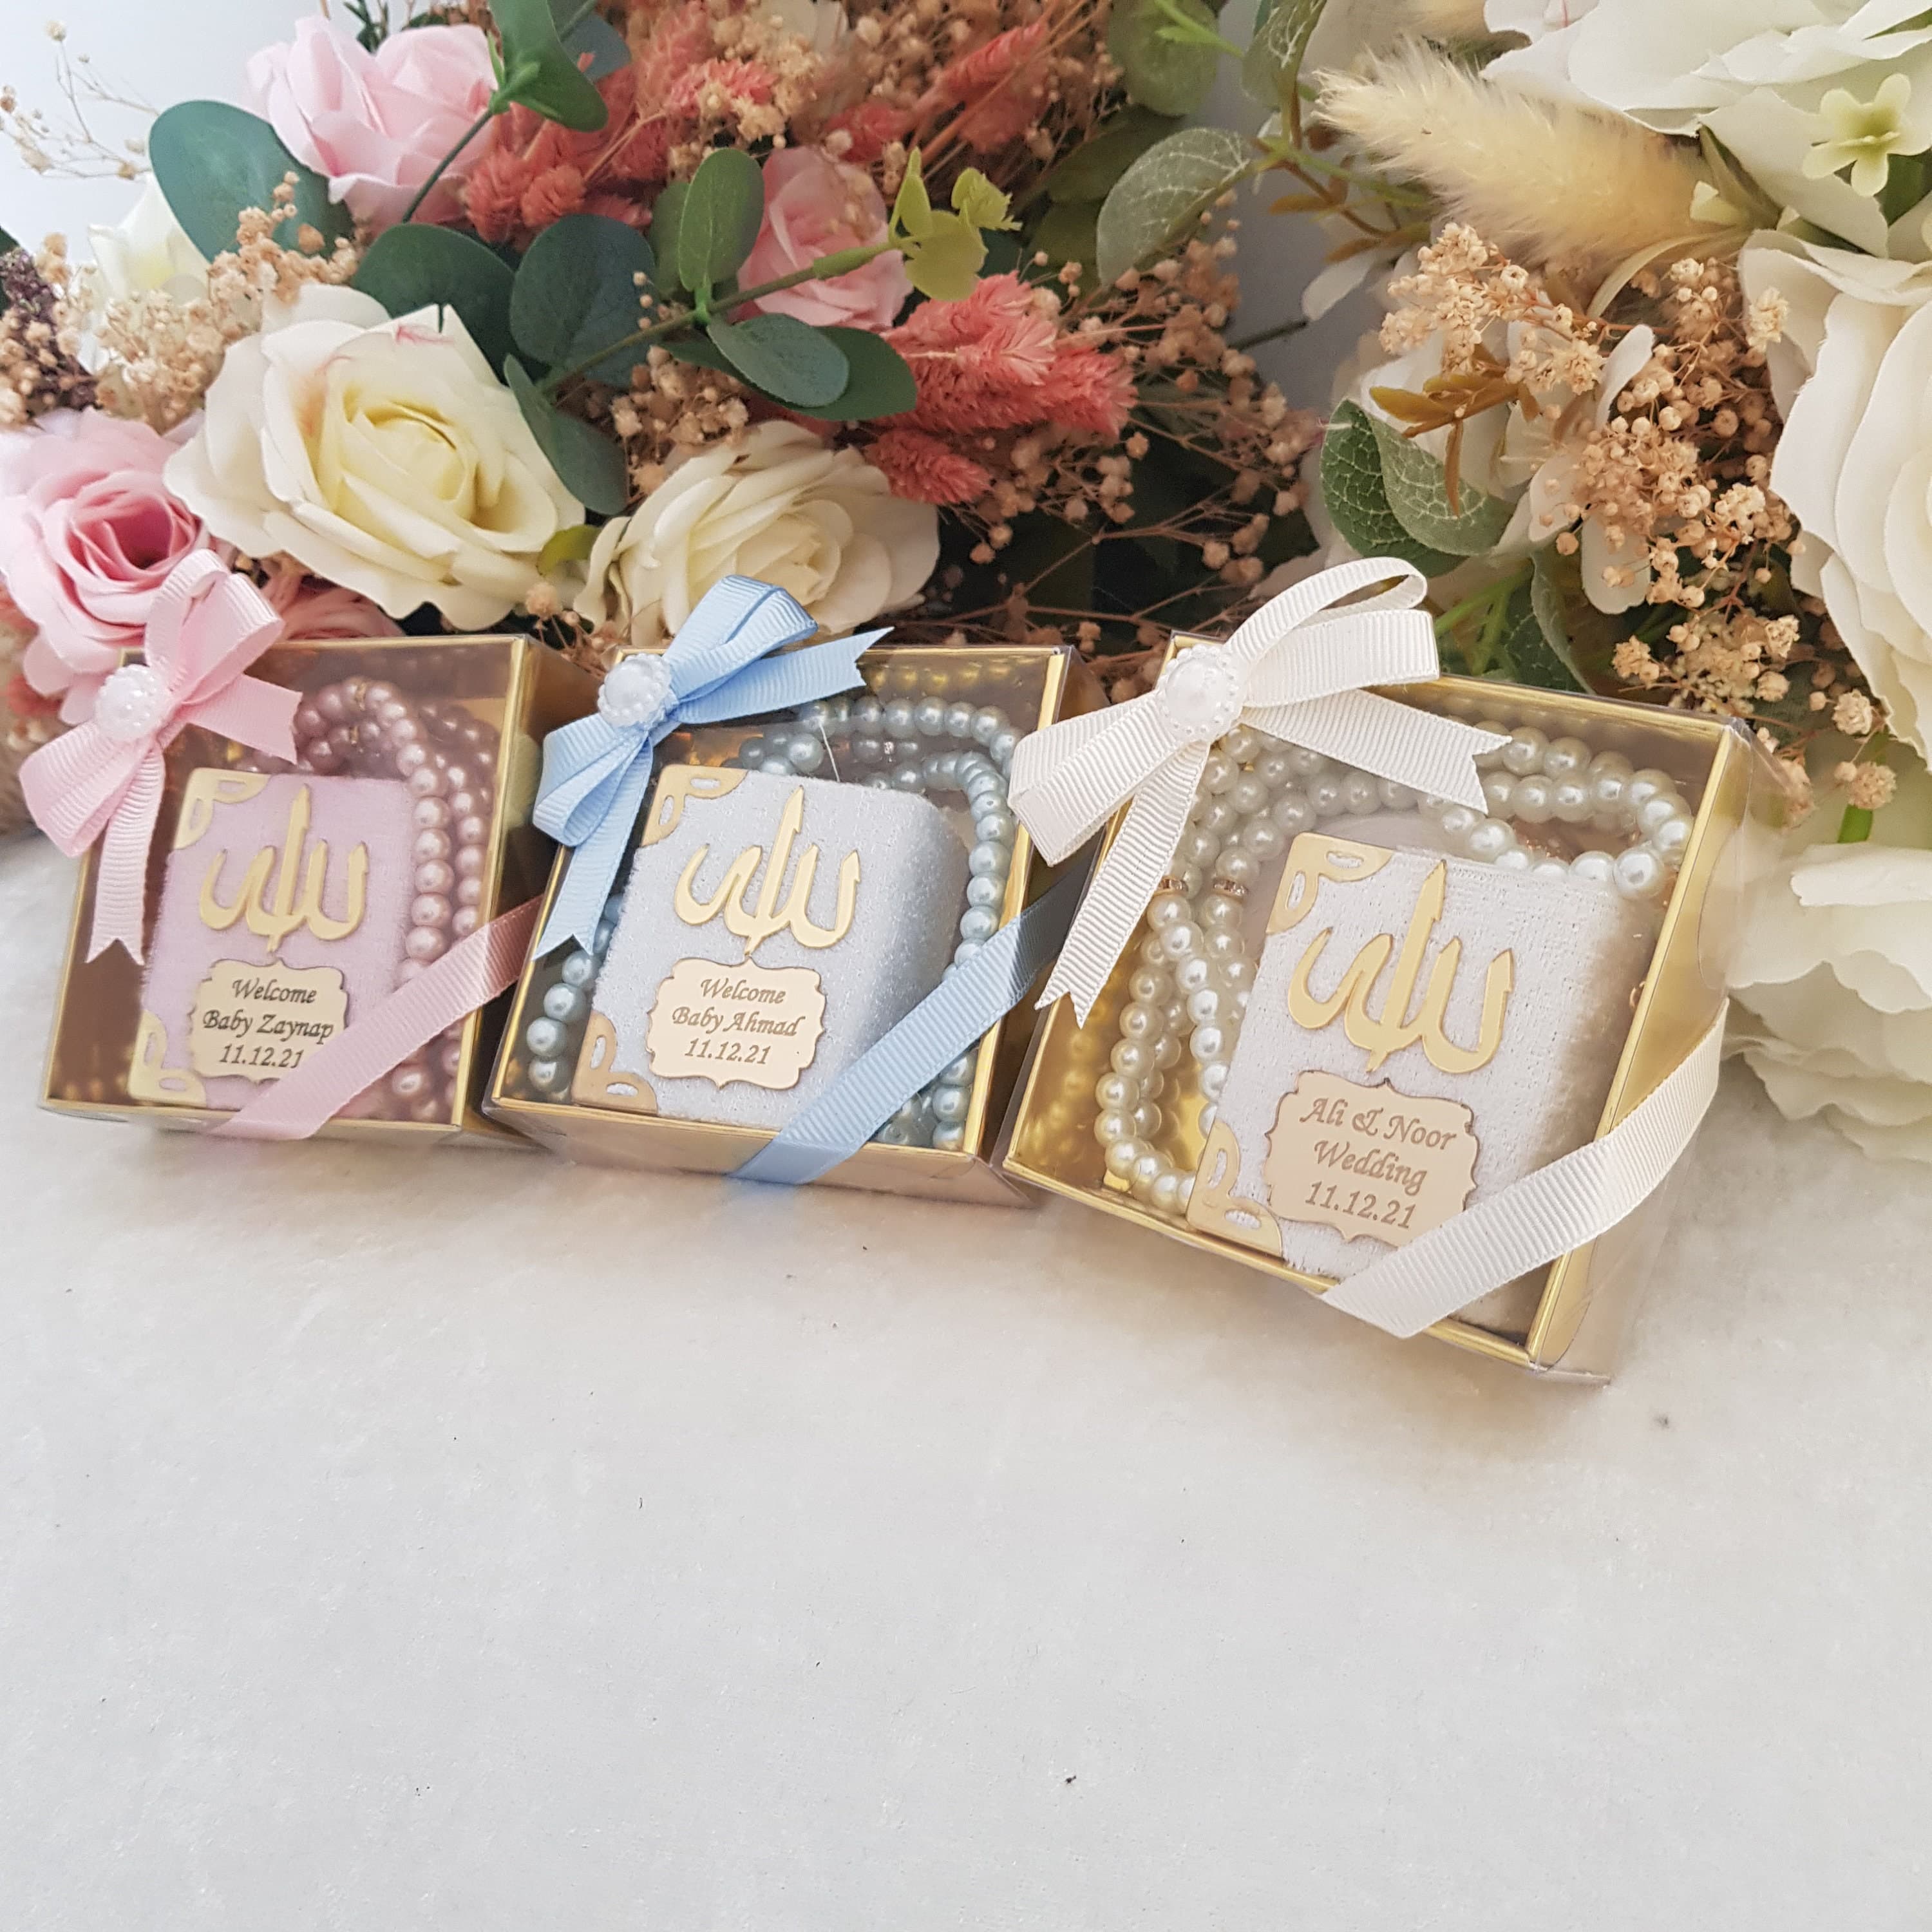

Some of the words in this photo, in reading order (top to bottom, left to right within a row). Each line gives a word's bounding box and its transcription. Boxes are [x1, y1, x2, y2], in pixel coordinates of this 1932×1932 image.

[232, 978, 317, 1003] Welcome
[700, 978, 786, 1004] Welcome
[202, 1009, 253, 1038] Baby
[256, 1014, 334, 1045] Zaynap
[672, 1006, 724, 1034] Baby
[723, 1011, 806, 1037] Ahmad
[219, 1043, 305, 1069] 11.12.21
[684, 1037, 772, 1065] 11.12.21
[1299, 1097, 1349, 1126] Ali
[1352, 1108, 1384, 1136] &
[1383, 1115, 1457, 1150] Noor
[1314, 1140, 1428, 1196] Wedding
[1305, 1180, 1417, 1229] 11.12.21
